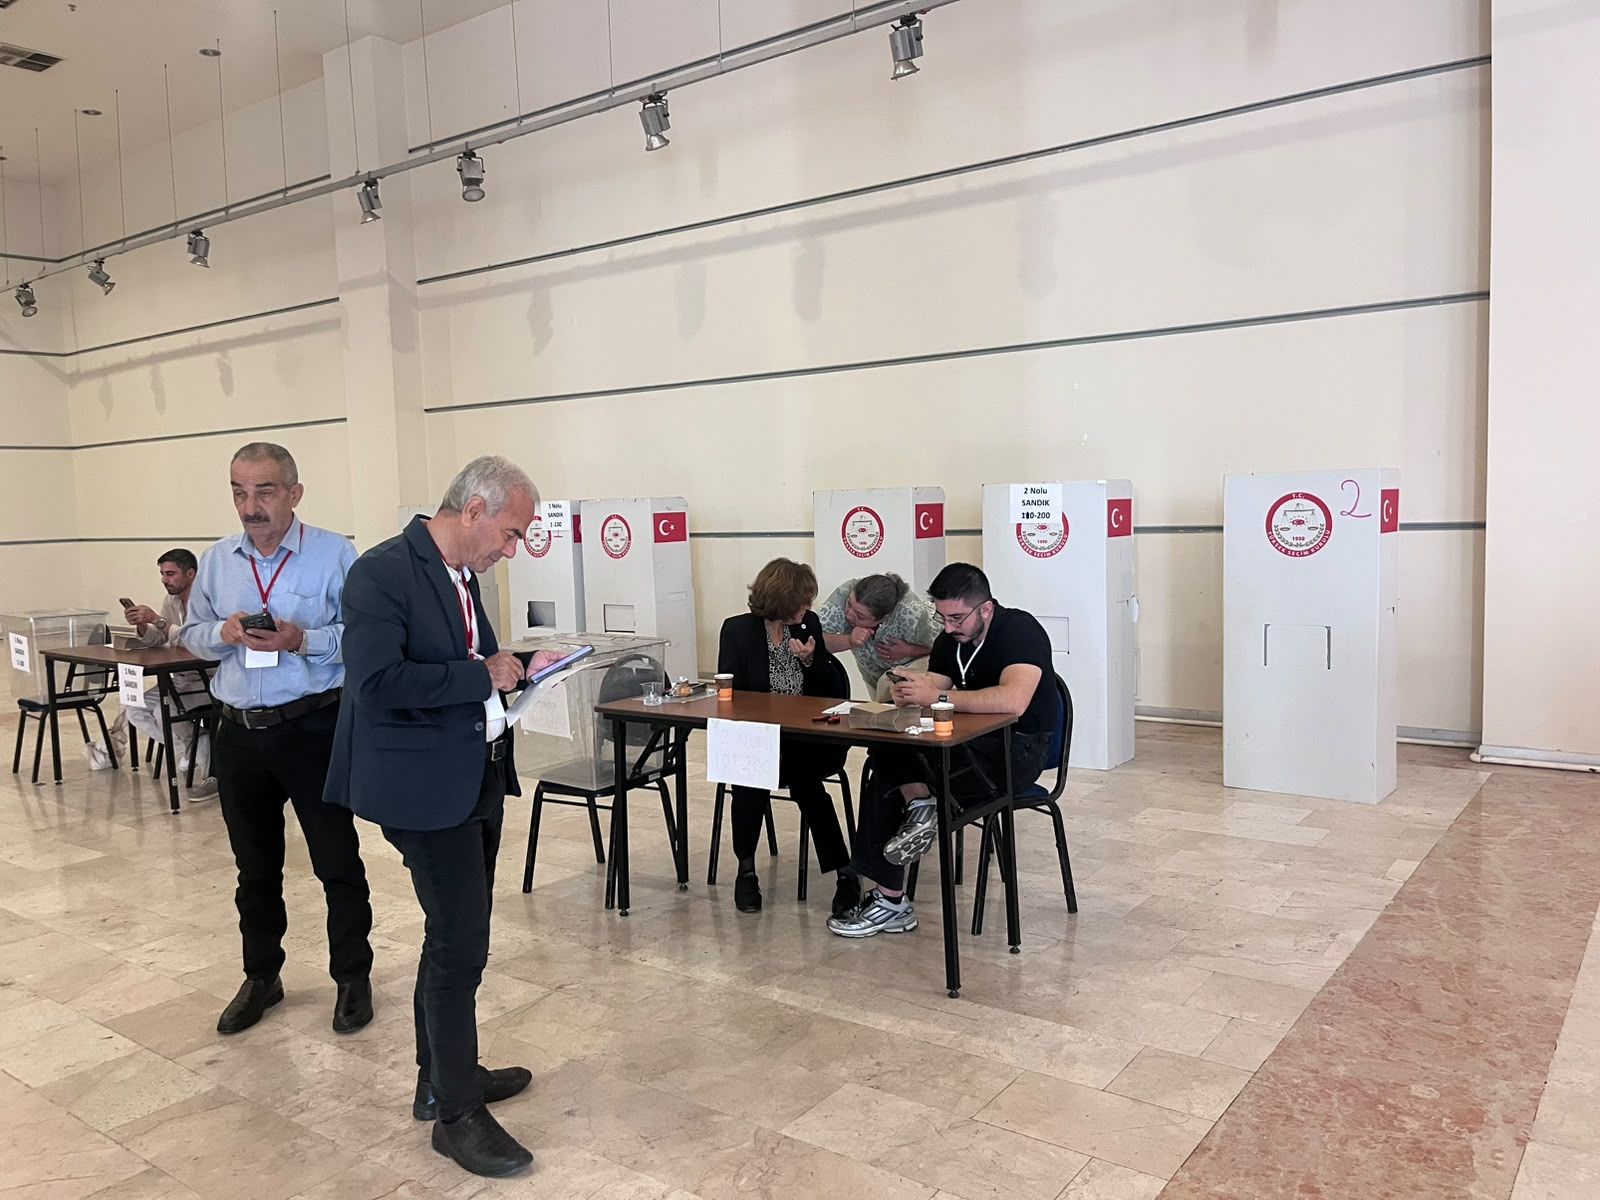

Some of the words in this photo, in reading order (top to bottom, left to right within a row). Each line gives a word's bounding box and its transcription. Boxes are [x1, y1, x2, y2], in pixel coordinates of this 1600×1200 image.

[1030, 487, 1048, 495] Nolu
[1339, 479, 1372, 518] 2
[1021, 499, 1050, 507] SANDIK
